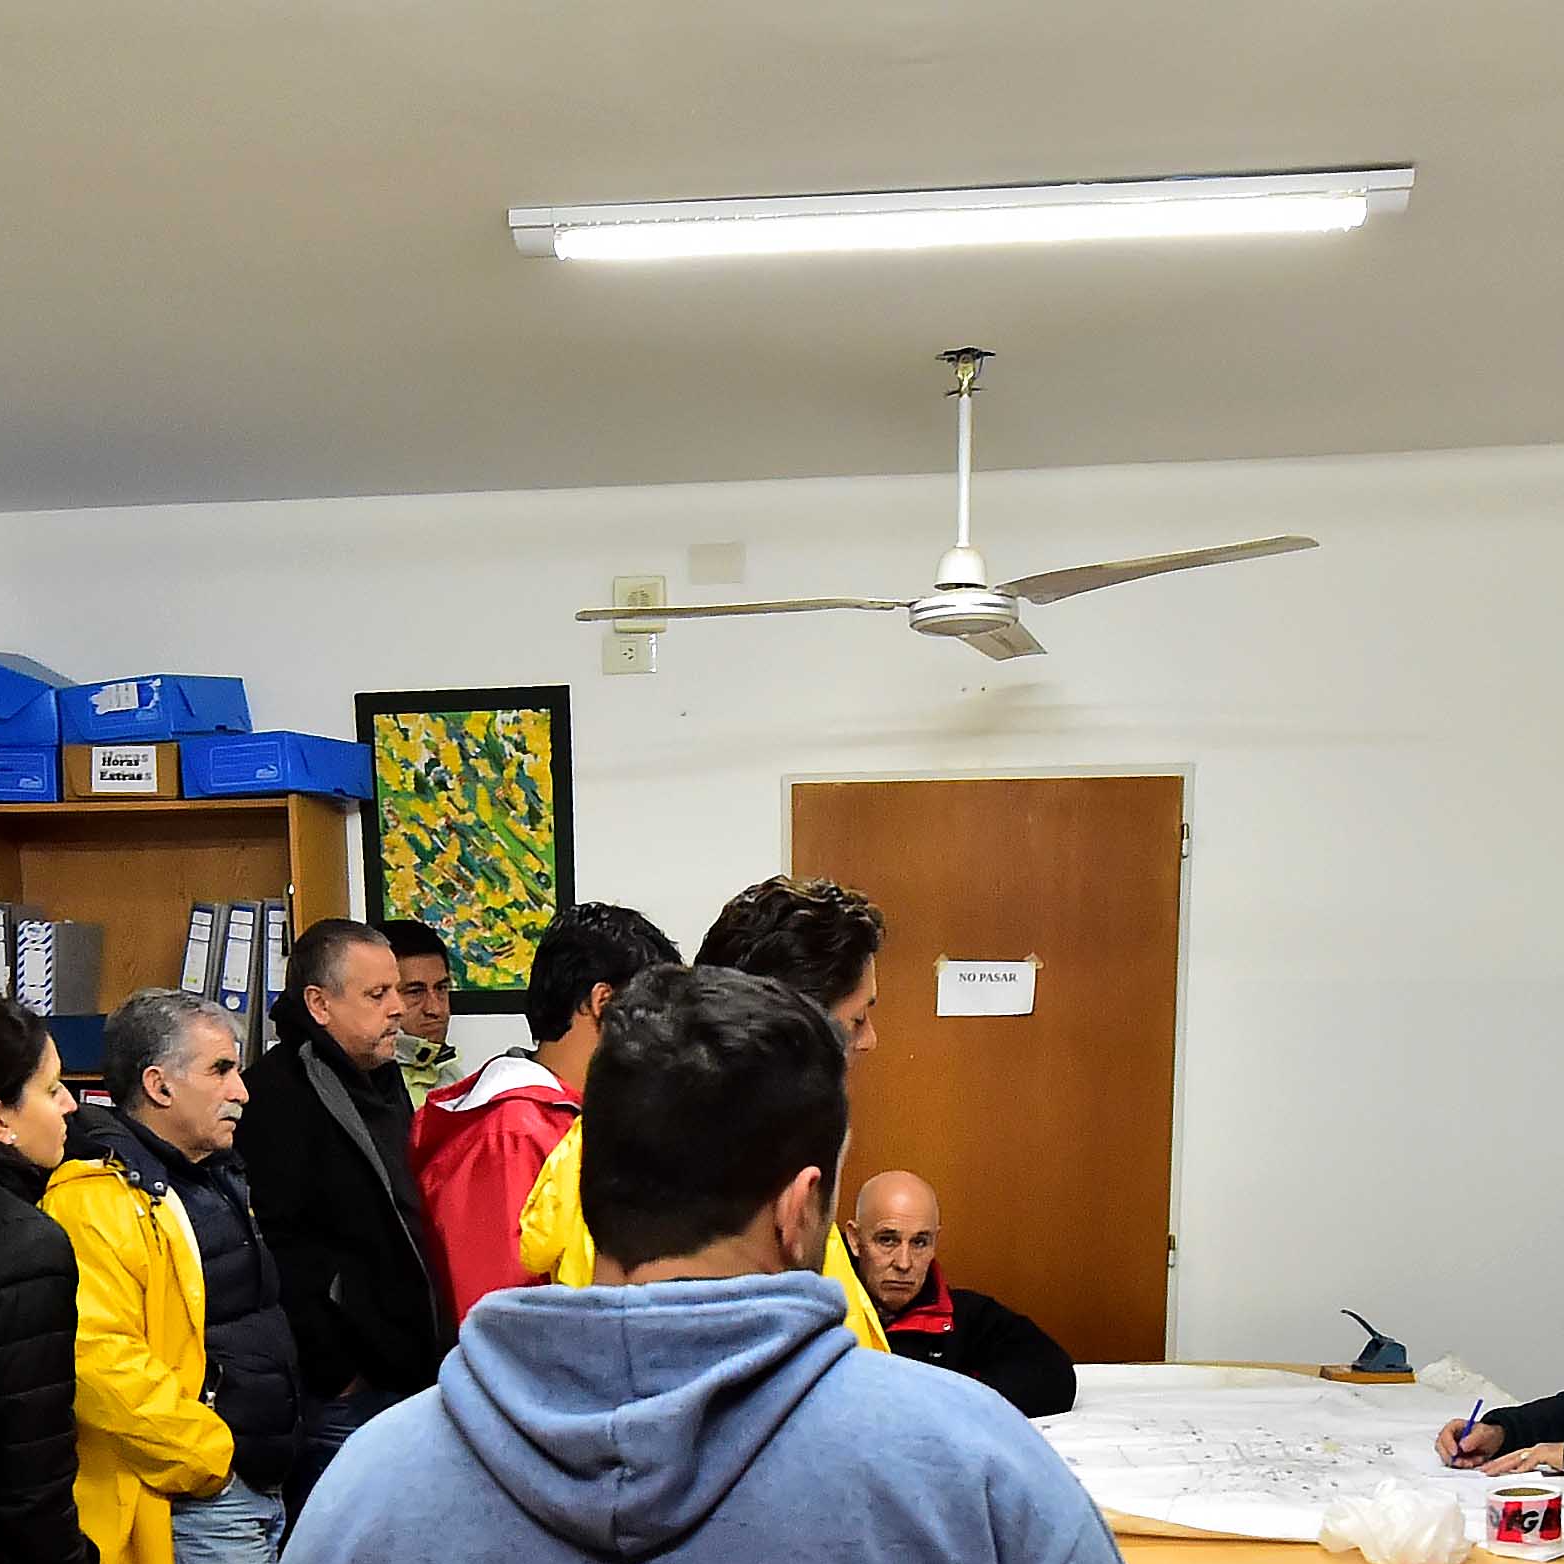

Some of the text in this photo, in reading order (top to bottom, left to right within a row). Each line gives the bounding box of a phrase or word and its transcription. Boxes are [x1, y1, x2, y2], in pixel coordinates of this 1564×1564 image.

[101, 754, 146, 767] Horas
[100, 770, 147, 781] Extras
[958, 972, 1018, 983] NO PASAR
